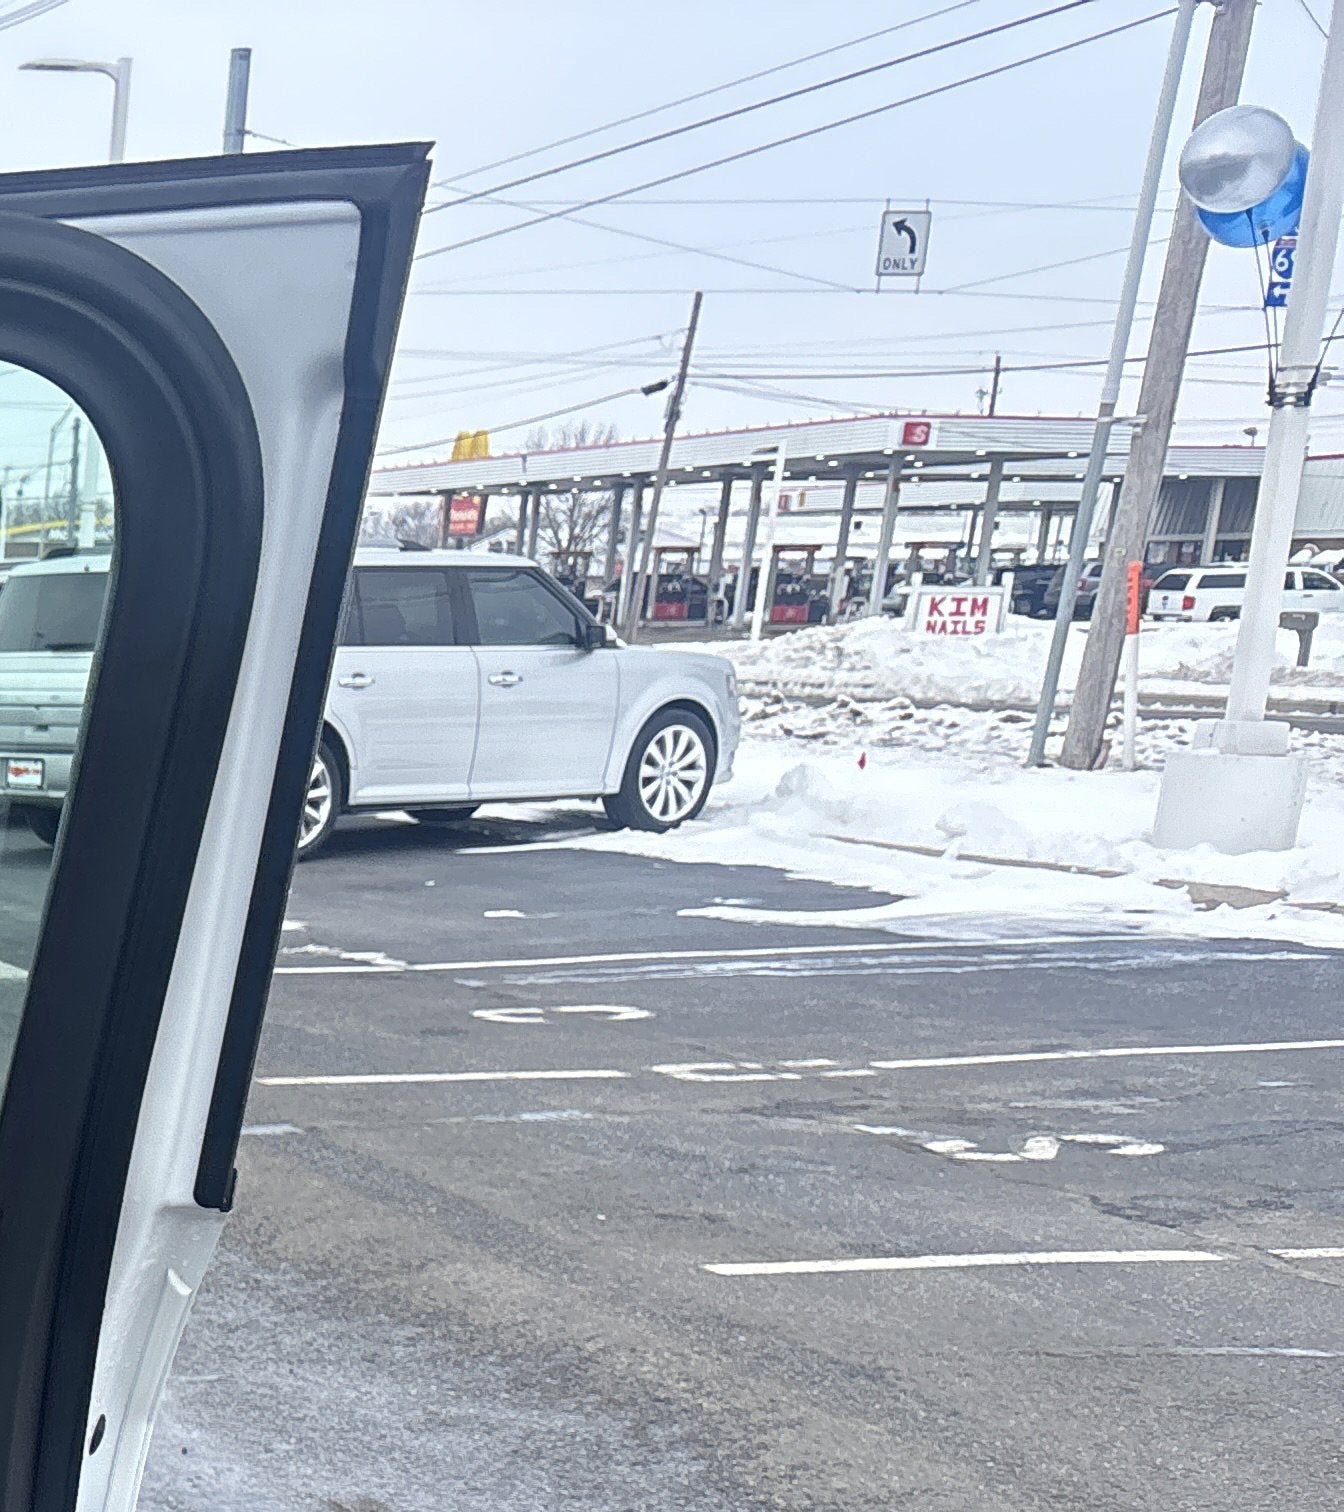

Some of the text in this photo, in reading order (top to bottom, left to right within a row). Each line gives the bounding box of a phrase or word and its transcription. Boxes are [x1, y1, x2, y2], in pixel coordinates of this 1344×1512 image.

[883, 258, 918, 270] ONLY
[928, 596, 989, 617] KIM
[926, 620, 986, 635] NAILS
